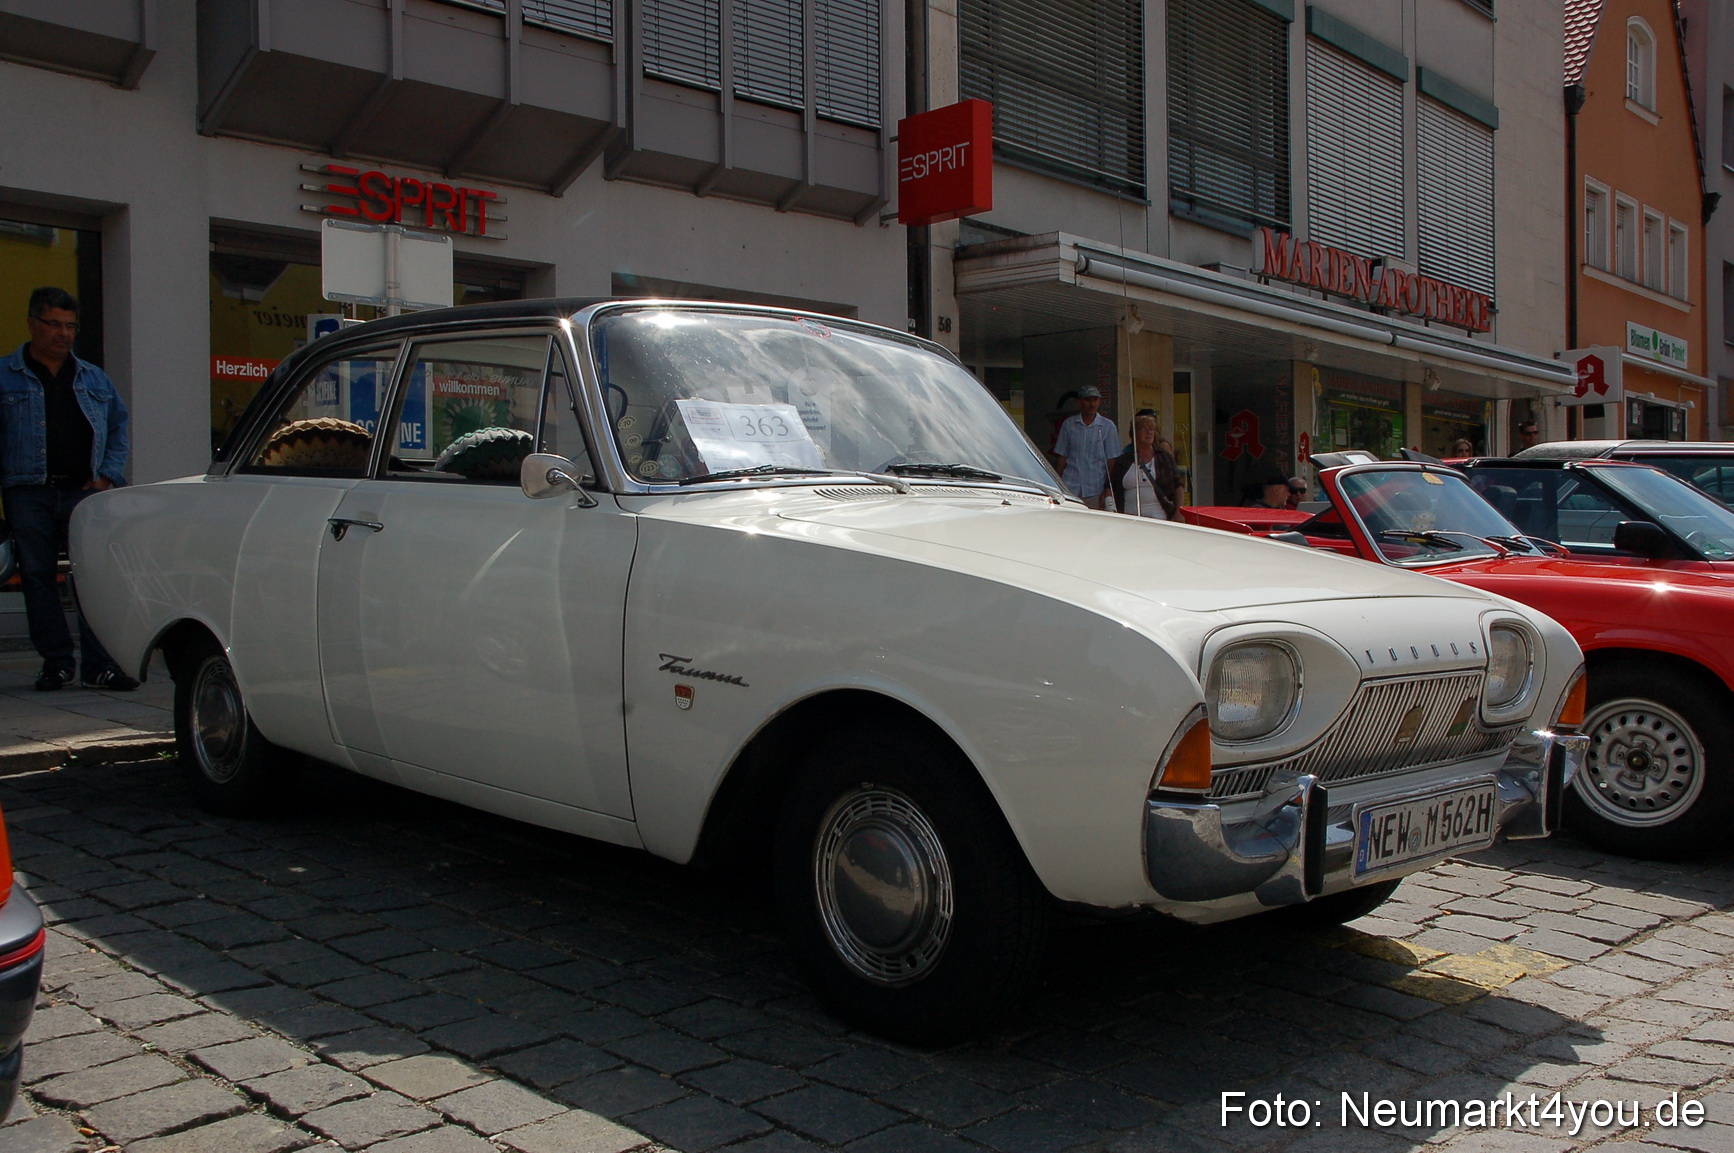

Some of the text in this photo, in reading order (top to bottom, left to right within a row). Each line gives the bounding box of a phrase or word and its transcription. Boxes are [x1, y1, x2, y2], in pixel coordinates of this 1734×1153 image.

[901, 141, 970, 182] ESPRIT
[326, 164, 498, 235] ESPRIT
[1262, 226, 1492, 333] MARIEN-APOTHEKE
[938, 316, 951, 333] 38
[1631, 329, 1650, 351] Blumen
[216, 360, 268, 378] Herzlich
[439, 380, 500, 396] willkommen
[739, 415, 789, 437] 363
[659, 653, 750, 687] Taunus
[1367, 810, 1411, 863] NEW
